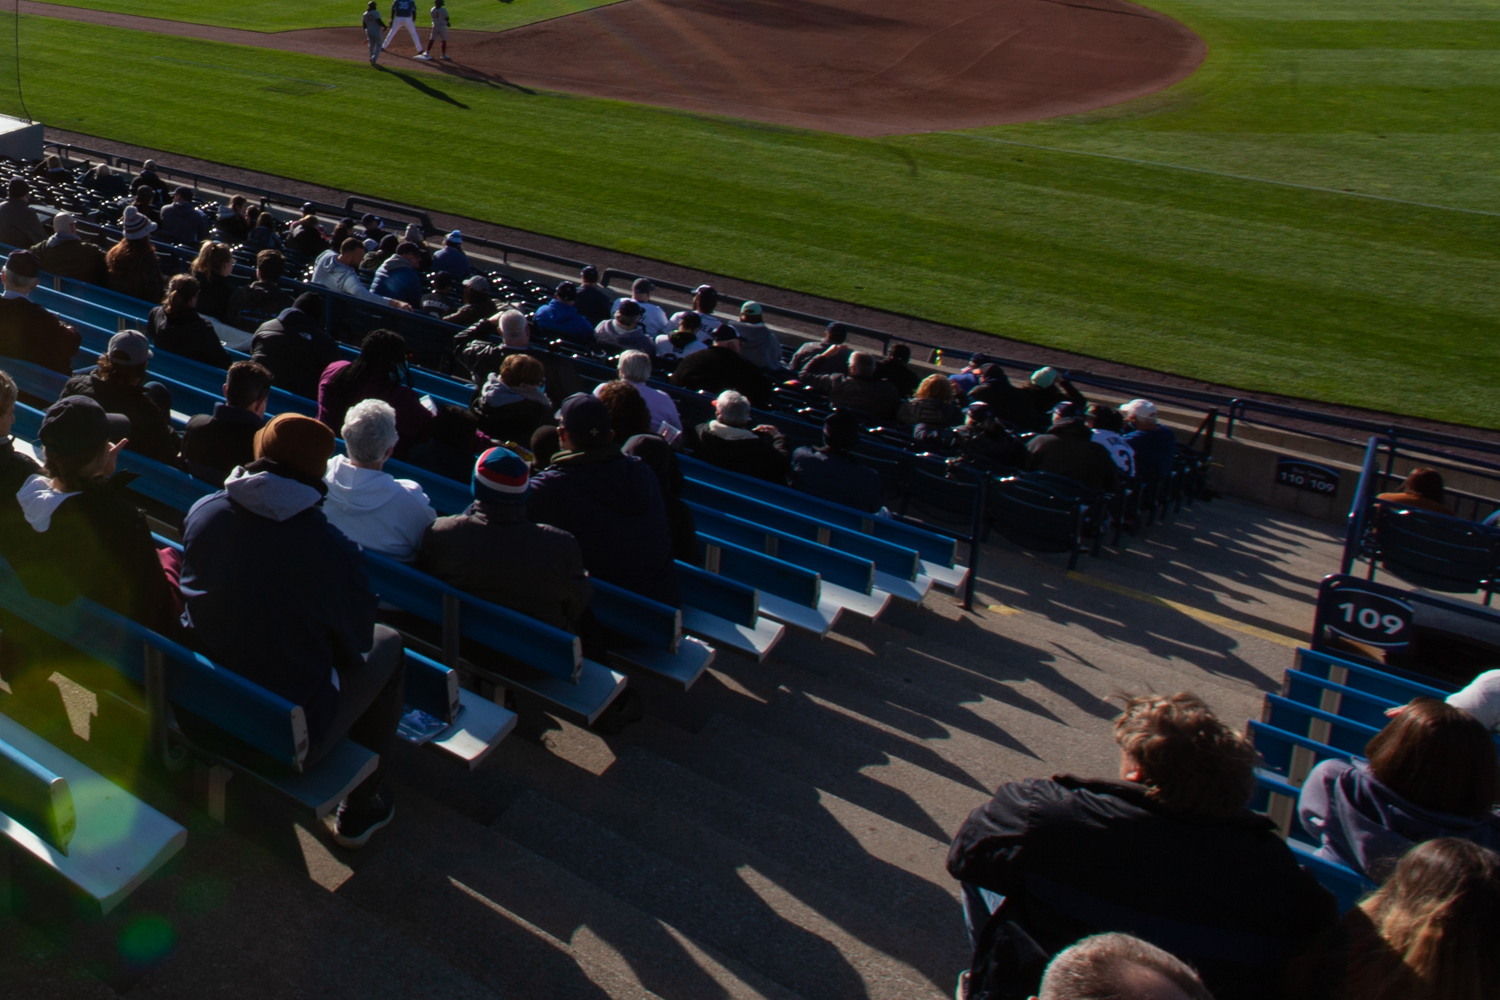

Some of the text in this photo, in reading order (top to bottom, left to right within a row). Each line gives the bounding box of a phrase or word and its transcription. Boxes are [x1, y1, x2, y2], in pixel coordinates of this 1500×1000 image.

[1279, 471, 1306, 485] 110
[1310, 479, 1336, 492] 109
[1337, 602, 1406, 635] 109
